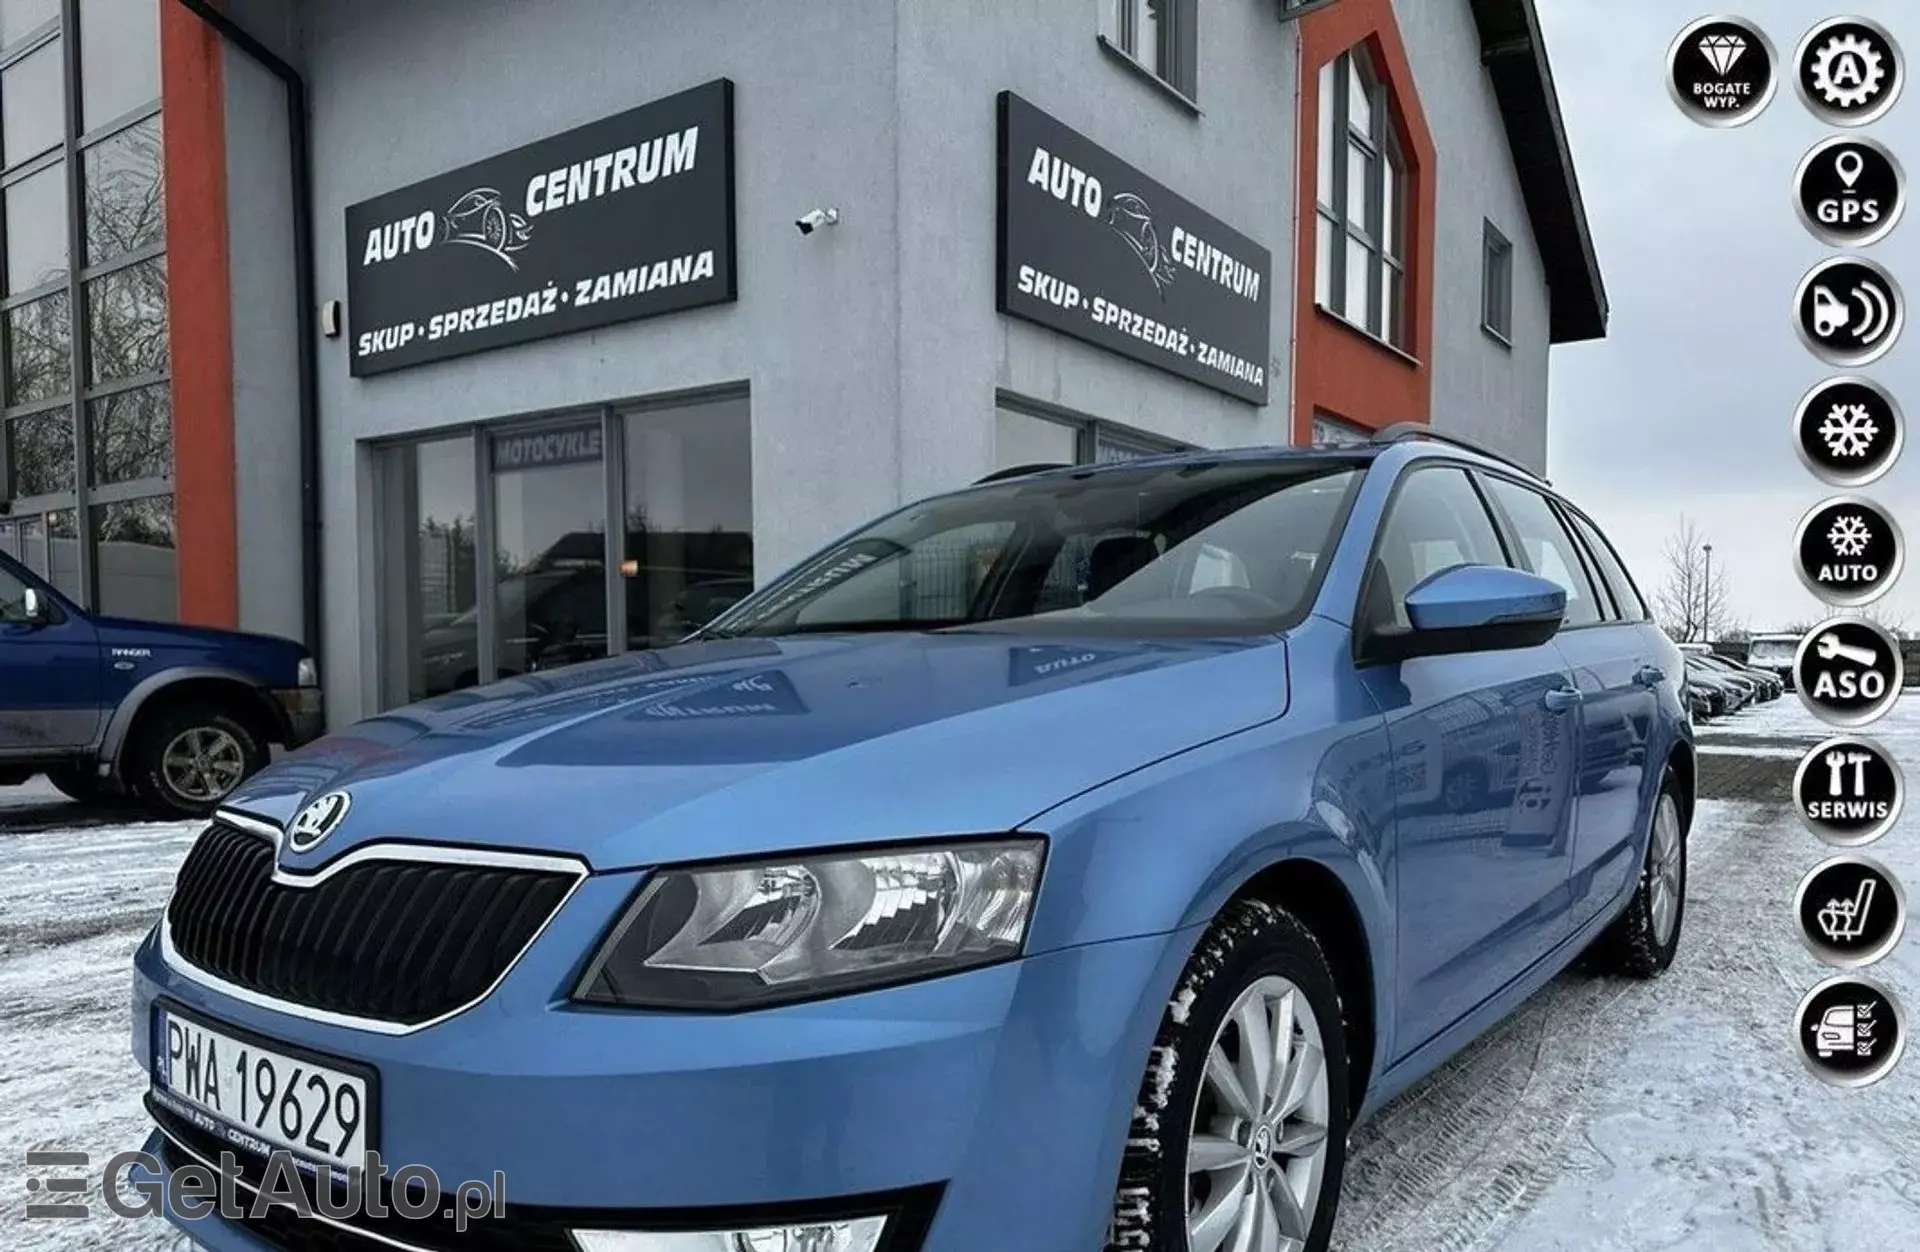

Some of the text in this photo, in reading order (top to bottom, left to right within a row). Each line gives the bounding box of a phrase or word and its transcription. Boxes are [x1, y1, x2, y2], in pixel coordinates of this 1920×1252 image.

[363, 126, 698, 266] AUTO CENTRUM
[1027, 146, 1261, 302] AUTO CENTRUM
[358, 250, 714, 357] SKUP SPRZEDAŻ ZAMIANA
[1018, 264, 1265, 388] SKUP SPRZEDAŻ ZAMIANA
[496, 429, 600, 465] MOTOCYKLE
[168, 1020, 360, 1158] PWA 19629
